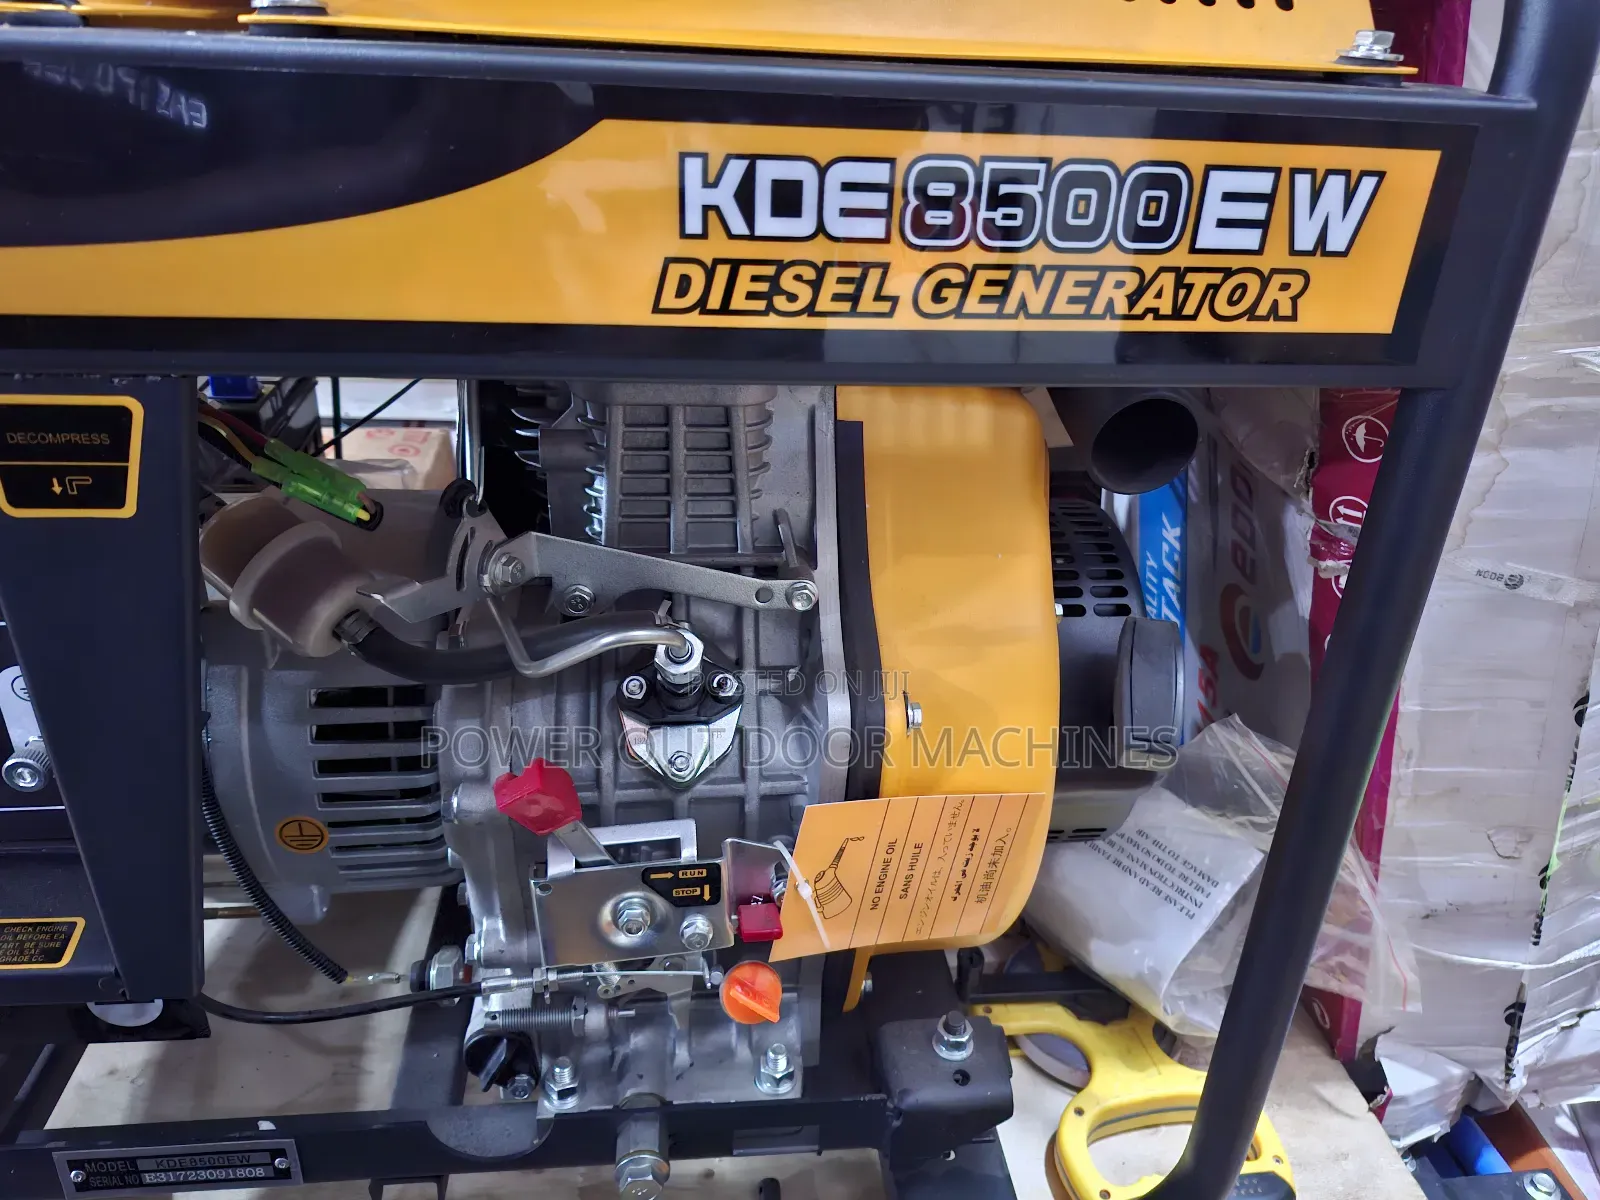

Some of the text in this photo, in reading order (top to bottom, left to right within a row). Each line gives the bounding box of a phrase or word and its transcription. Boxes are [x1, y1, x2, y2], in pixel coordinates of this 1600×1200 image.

[678, 152, 1386, 256] KDE8500EW
[653, 257, 1309, 322] DIESEL GENERATOR
[6, 432, 110, 445] DECOMPRESS
[1145, 550, 1158, 619] ALITY
[1126, 836, 1141, 851] MAY
[1140, 847, 1153, 858] SO
[1152, 839, 1168, 853] THE
[1112, 858, 1123, 868] BE
[1117, 845, 1149, 871] MANUAL
[1152, 854, 1165, 867] DO
[1167, 849, 1180, 861] TO
[870, 838, 898, 910] NO ENGINE OIL
[899, 842, 923, 900] SANS HUILE
[975, 827, 1012, 904] 机油尚未加入。
[1121, 865, 1138, 879] AND
[1164, 863, 1177, 875] TO
[1182, 859, 1220, 889] DAMAGE
[1138, 876, 1163, 896] READ
[1149, 867, 1204, 909] INSTRUCTION
[1178, 872, 1212, 899] FAILURE
[1164, 895, 1196, 920] PLEASE
[16, 933, 52, 941] BEFORE
[84, 1154, 250, 1173] MODEL KDE8500EW
[89, 1167, 265, 1187] SERIAL NO E31723091808
